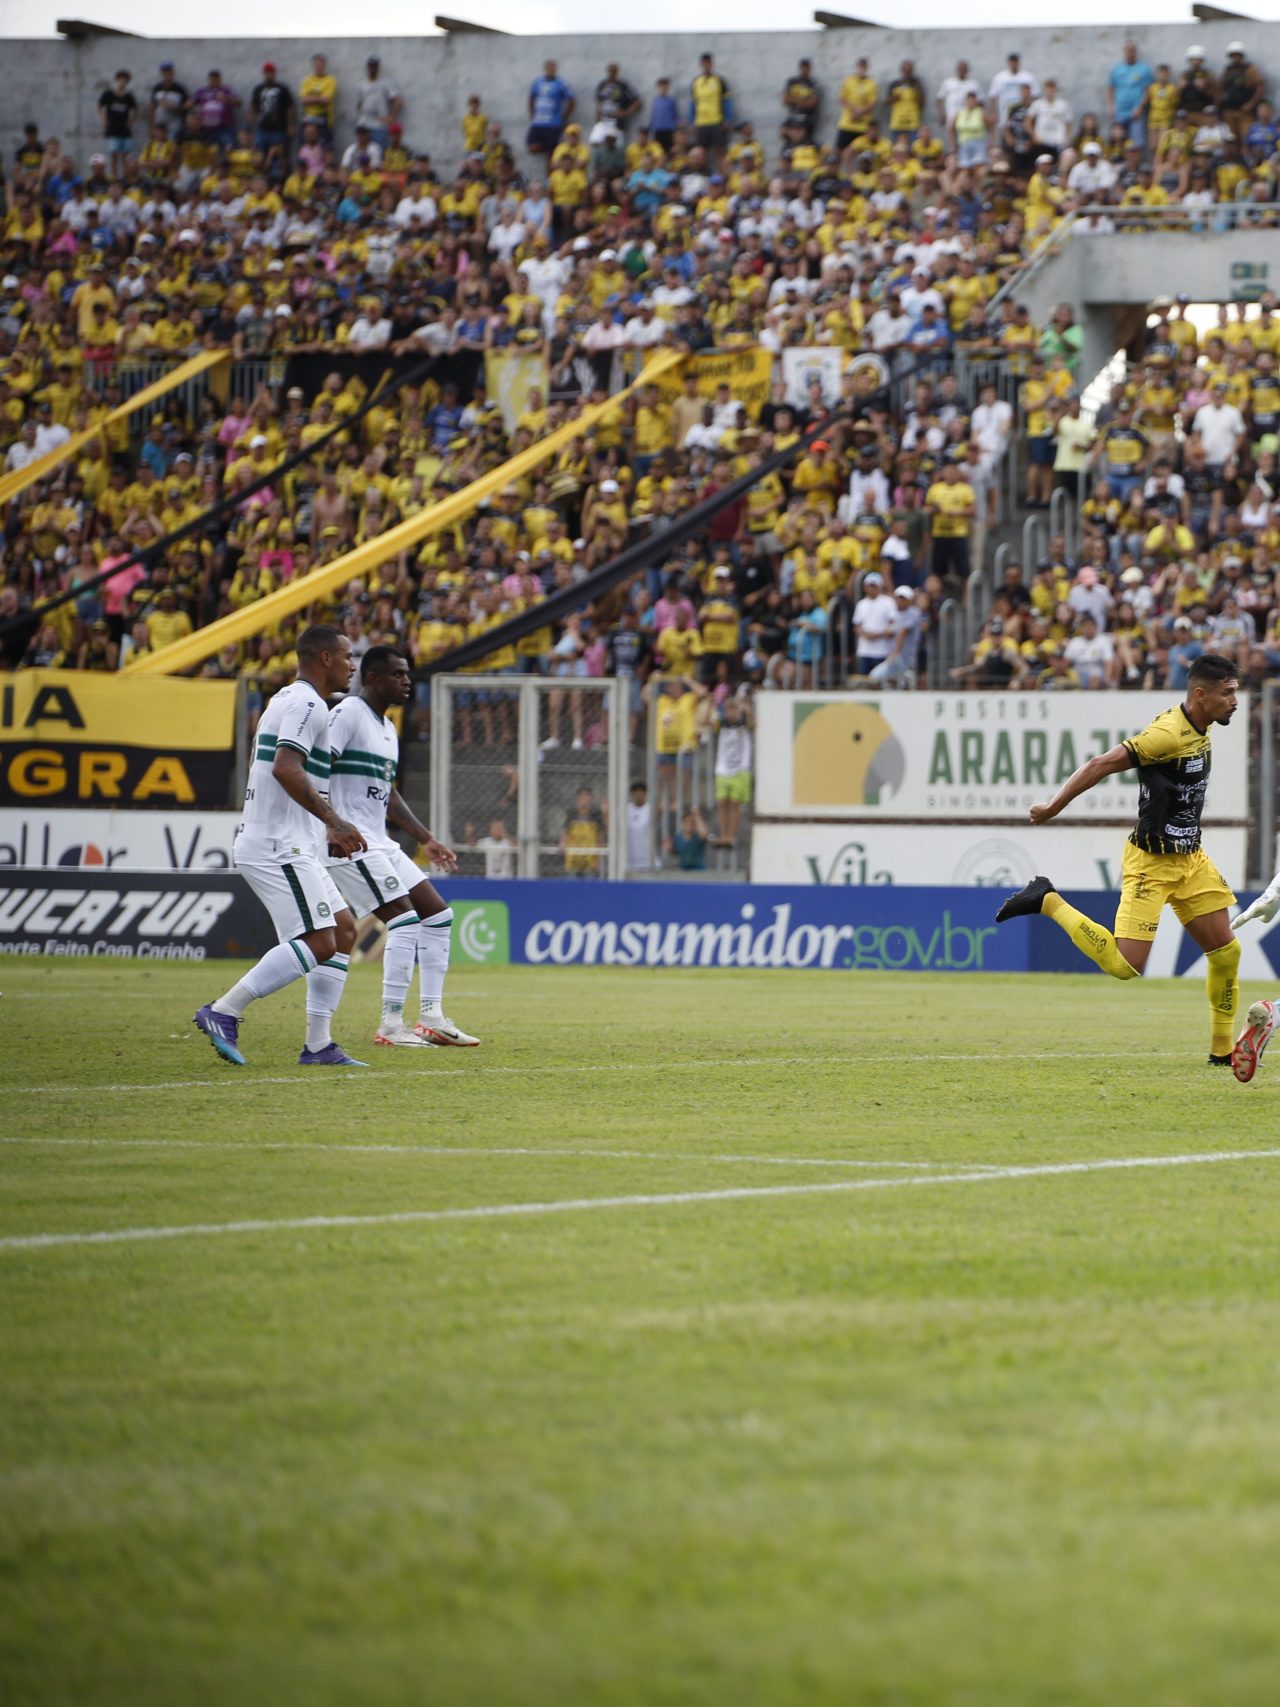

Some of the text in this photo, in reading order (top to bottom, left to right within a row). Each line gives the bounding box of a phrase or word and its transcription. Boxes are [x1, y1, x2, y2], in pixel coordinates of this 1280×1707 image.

[935, 699, 1050, 719] POSTOS
[0, 749, 196, 804] GRA
[806, 841, 896, 886] Vila
[0, 888, 235, 937] UCATUR
[44, 939, 90, 957] Feito
[93, 940, 134, 959] Com
[137, 942, 206, 960] Carinho
[524, 902, 997, 971] consumidor.gov.br
